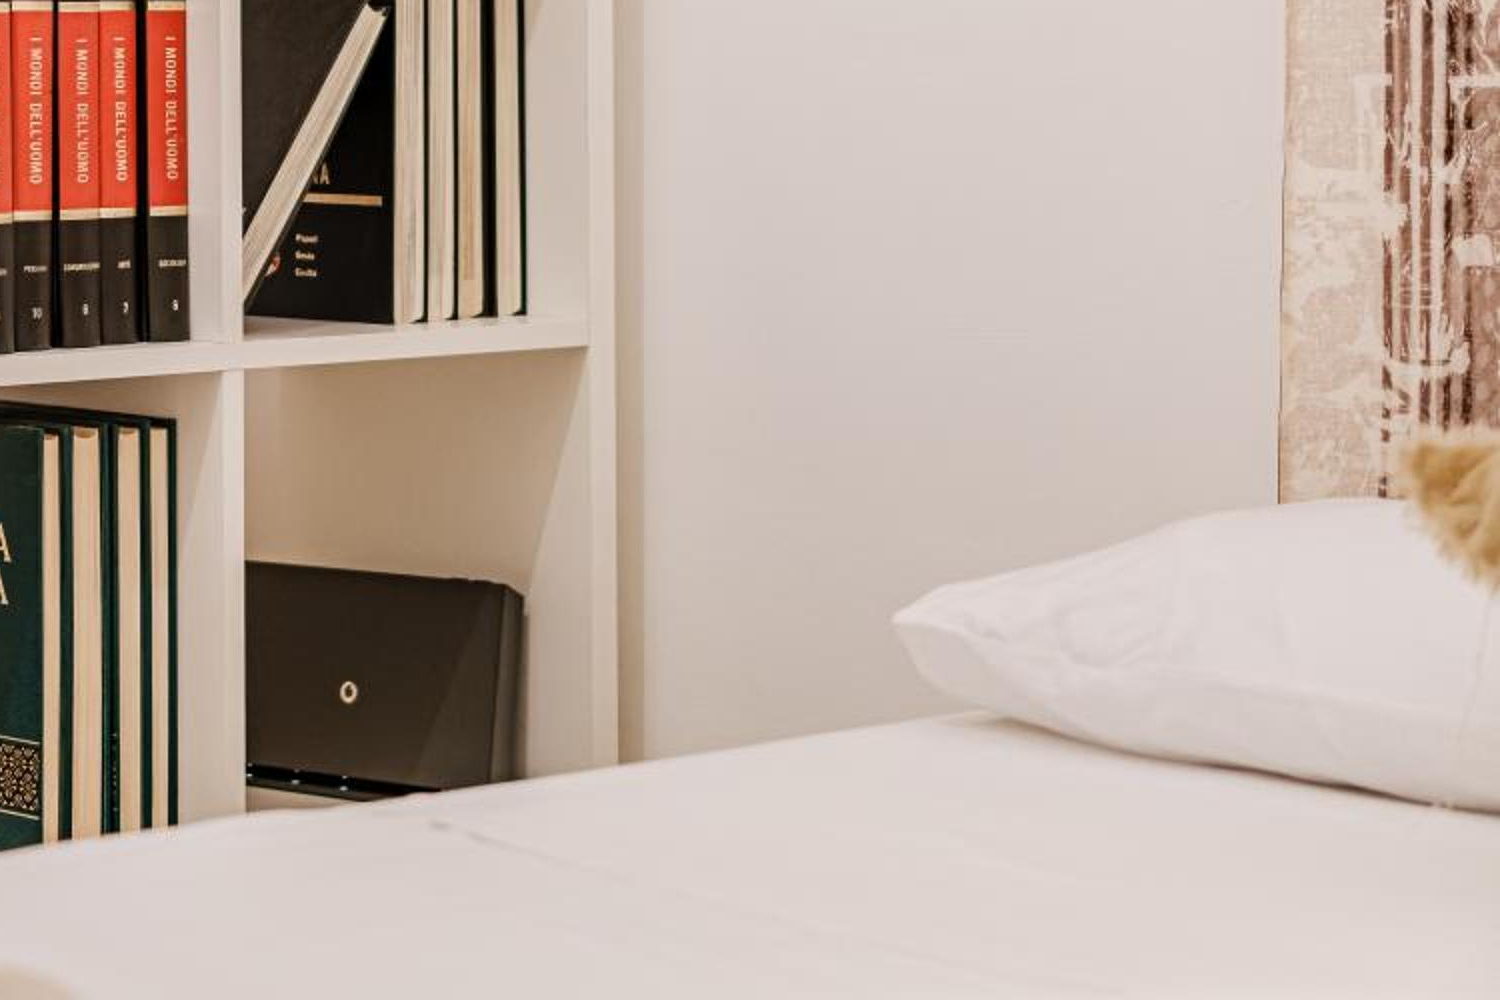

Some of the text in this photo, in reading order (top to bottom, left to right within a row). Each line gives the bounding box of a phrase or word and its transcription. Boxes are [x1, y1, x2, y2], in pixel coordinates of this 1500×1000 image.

[29, 48, 43, 95] MONDI
[76, 49, 89, 95] MONDI
[114, 47, 127, 94] MONDI
[165, 47, 177, 93] MONDI
[29, 103, 43, 184] DELL'UOMO
[76, 103, 90, 183] DELL'UOMO
[115, 101, 128, 182] DELL'UOMO
[165, 101, 179, 180] DELL'UOMO
